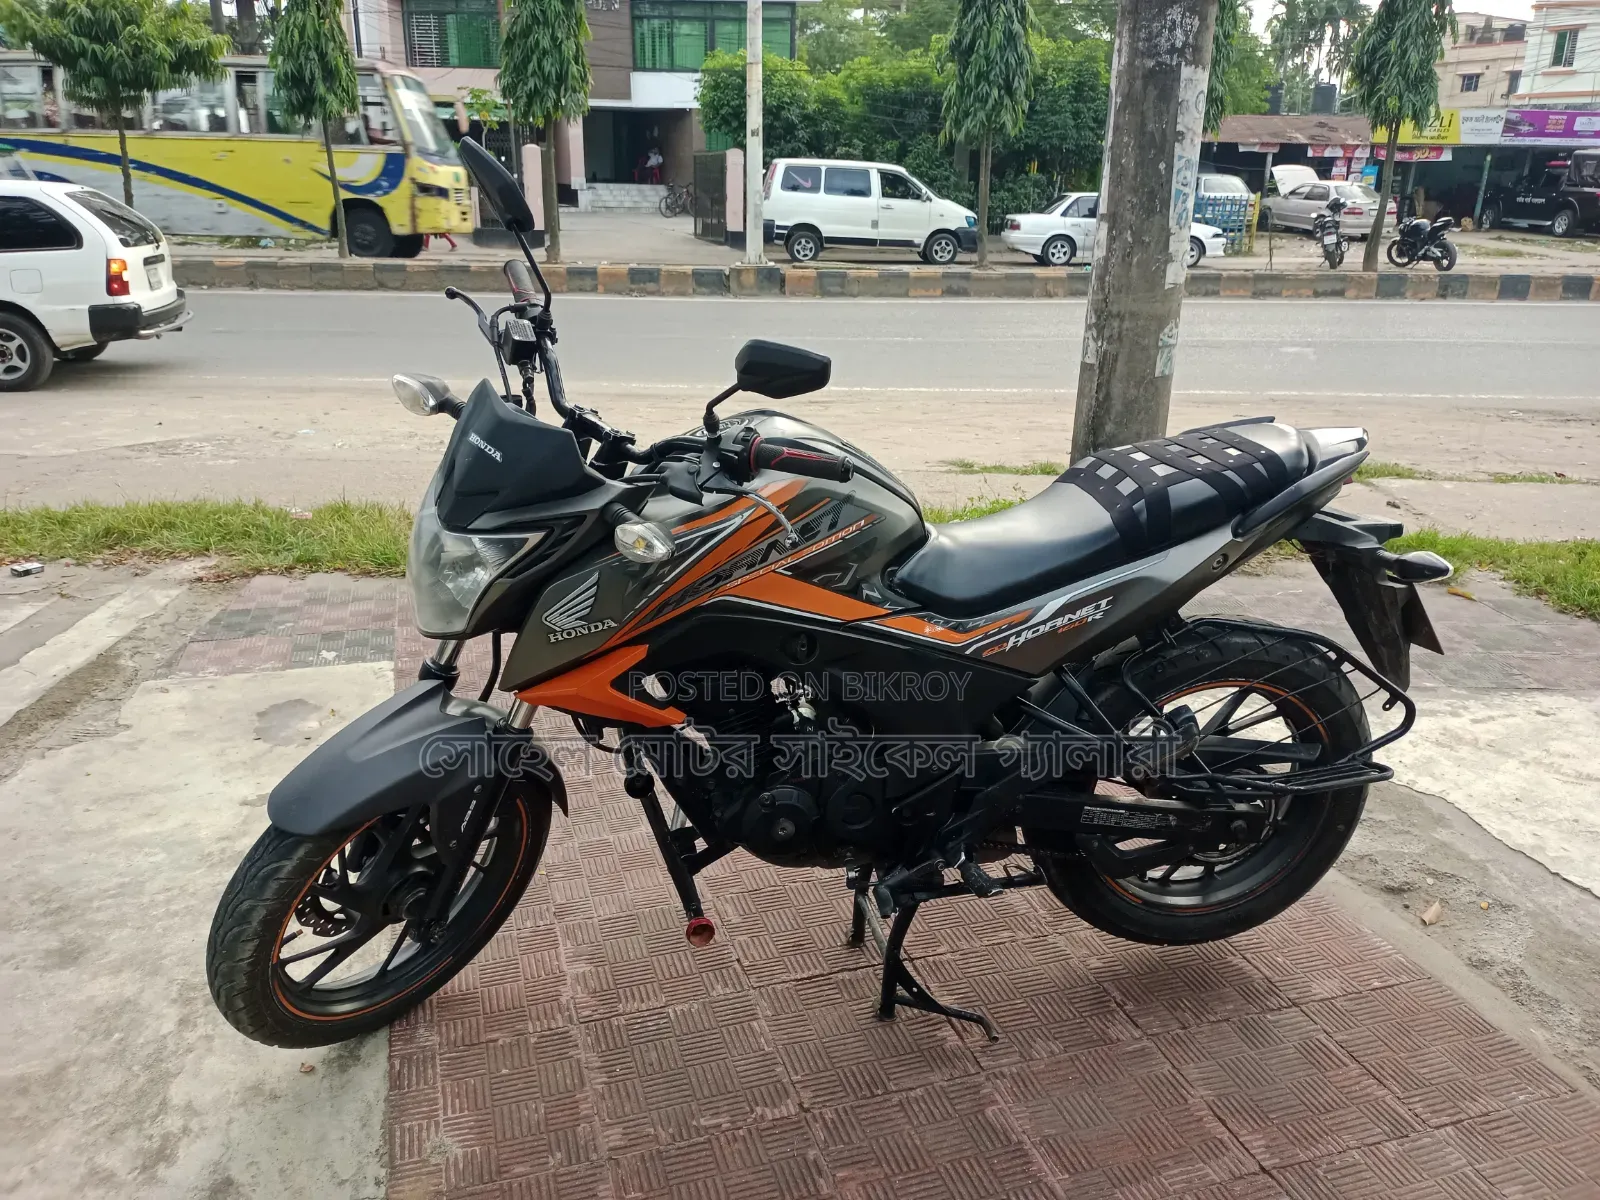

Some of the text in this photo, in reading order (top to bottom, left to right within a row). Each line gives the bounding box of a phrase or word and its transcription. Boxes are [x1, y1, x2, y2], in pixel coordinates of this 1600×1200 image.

[468, 432, 503, 463] HONDA
[726, 519, 865, 590] SPECIAL EDITION
[548, 618, 619, 643] HONDA
[1005, 596, 1114, 652] HORNET
